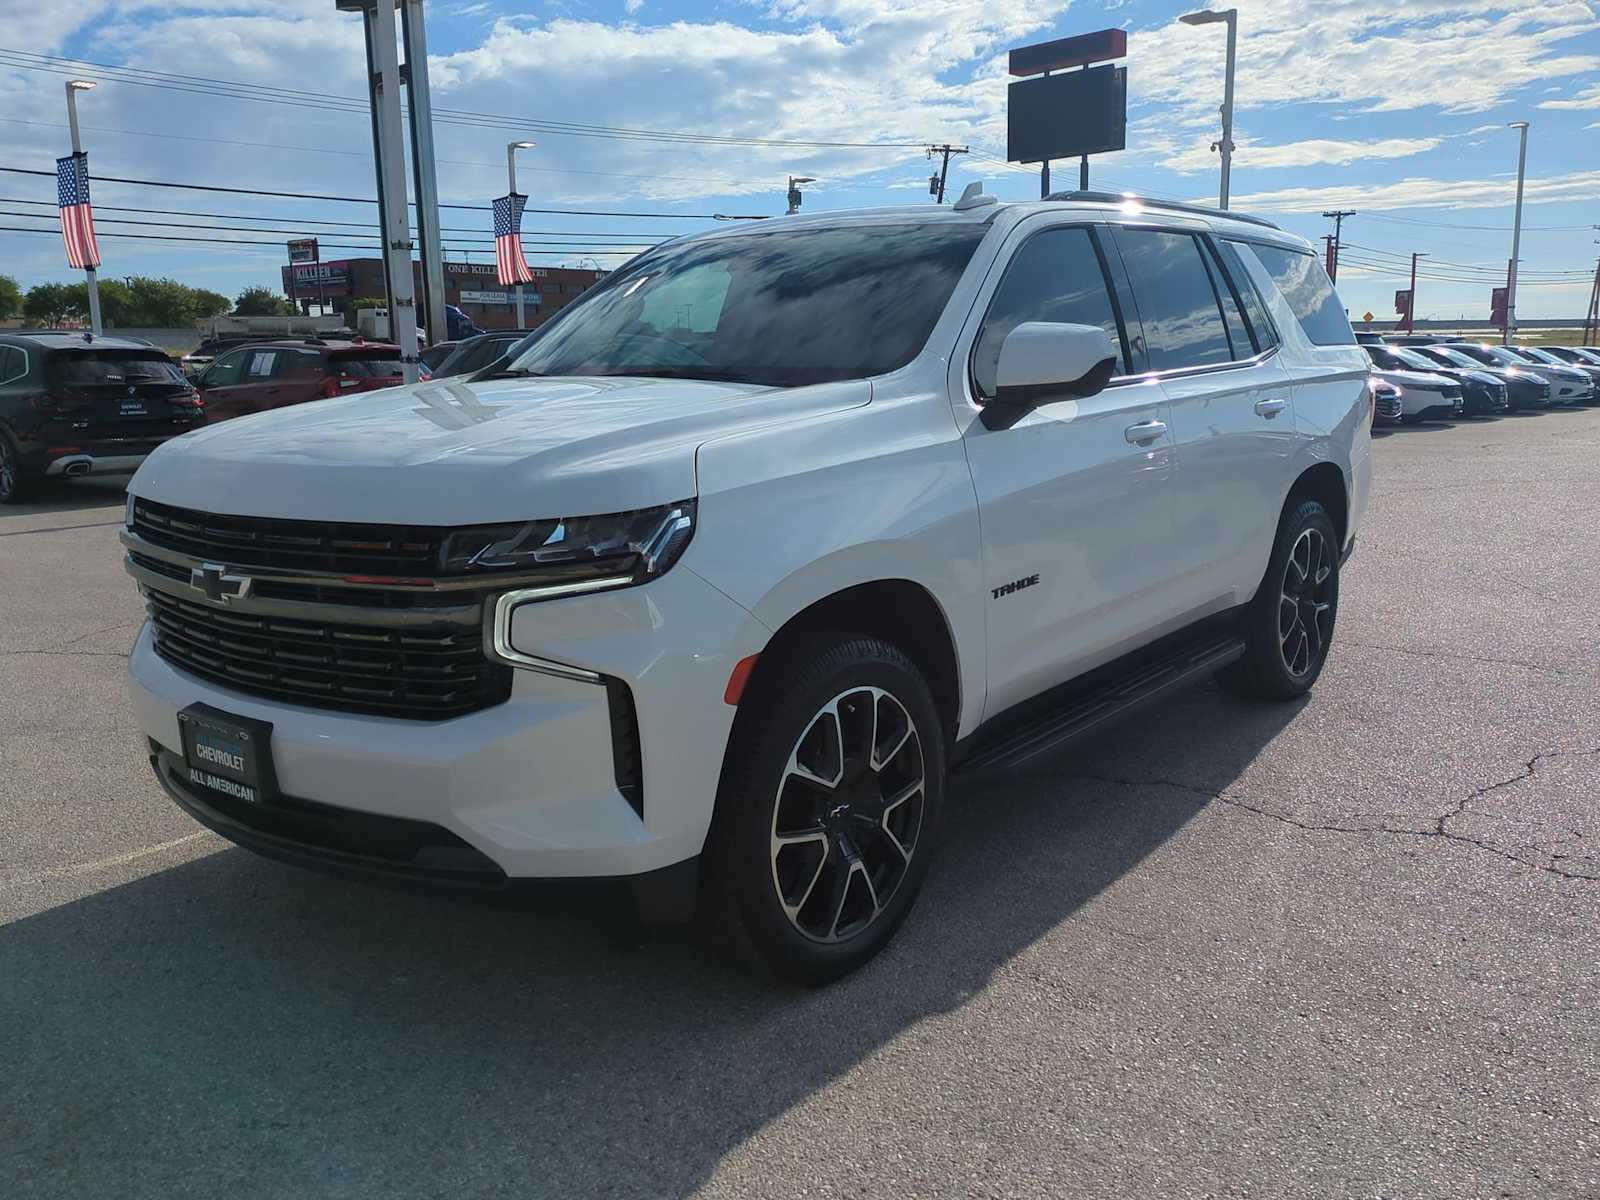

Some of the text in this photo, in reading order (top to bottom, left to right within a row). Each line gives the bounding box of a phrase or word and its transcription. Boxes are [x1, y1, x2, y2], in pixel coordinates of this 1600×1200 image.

[448, 265, 469, 275] ONE
[991, 573, 1040, 600] TAHOE
[196, 743, 245, 772] CHEVROLET
[190, 768, 255, 802] ALL AMERICAN
